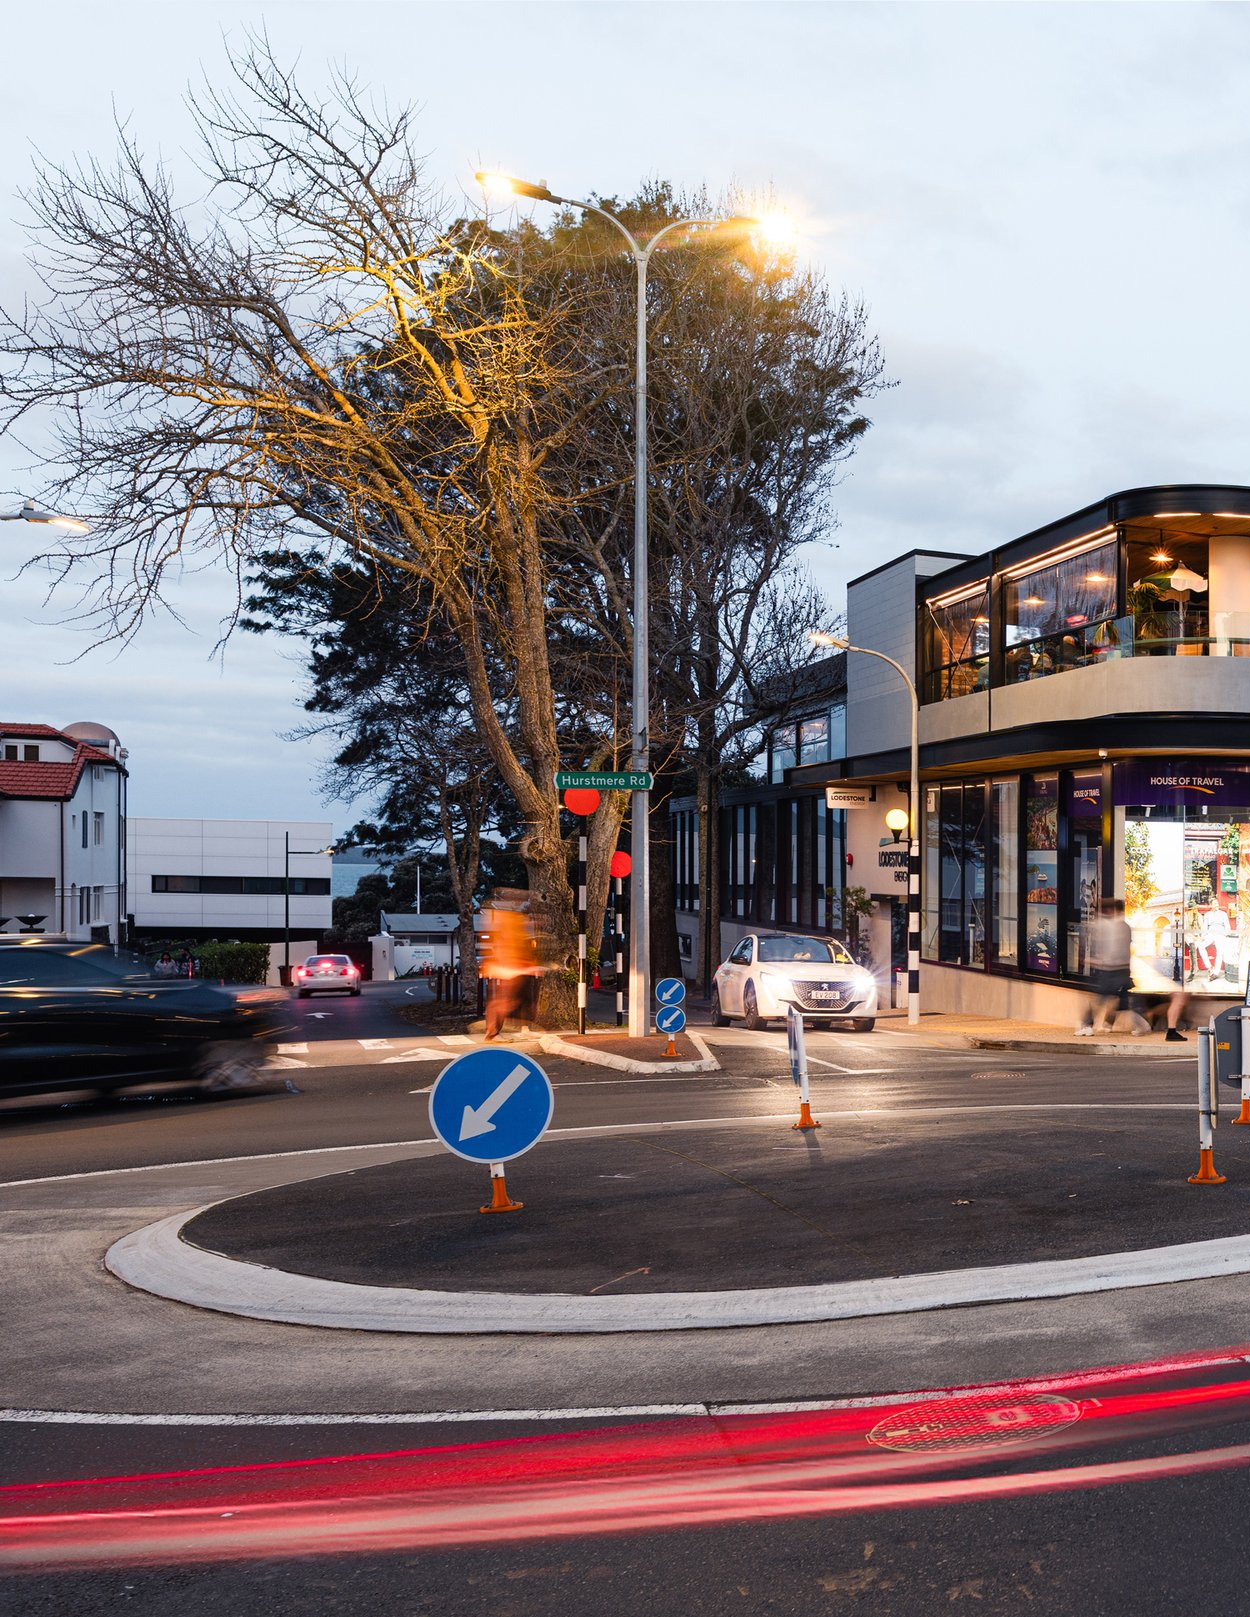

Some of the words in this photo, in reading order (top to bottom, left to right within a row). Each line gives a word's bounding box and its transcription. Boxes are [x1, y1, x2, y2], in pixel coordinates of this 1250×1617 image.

[561, 775, 625, 786] Hurstmere
[630, 775, 646, 786] Rd
[1150, 777, 1178, 785] HOUSE
[1178, 777, 1191, 785] OF
[1191, 777, 1225, 786] TRAVEL
[1073, 789, 1084, 798] HOUSE
[1084, 789, 1089, 797] OF
[1088, 788, 1100, 797] TRAVEL
[830, 794, 866, 802] LODESTONE
